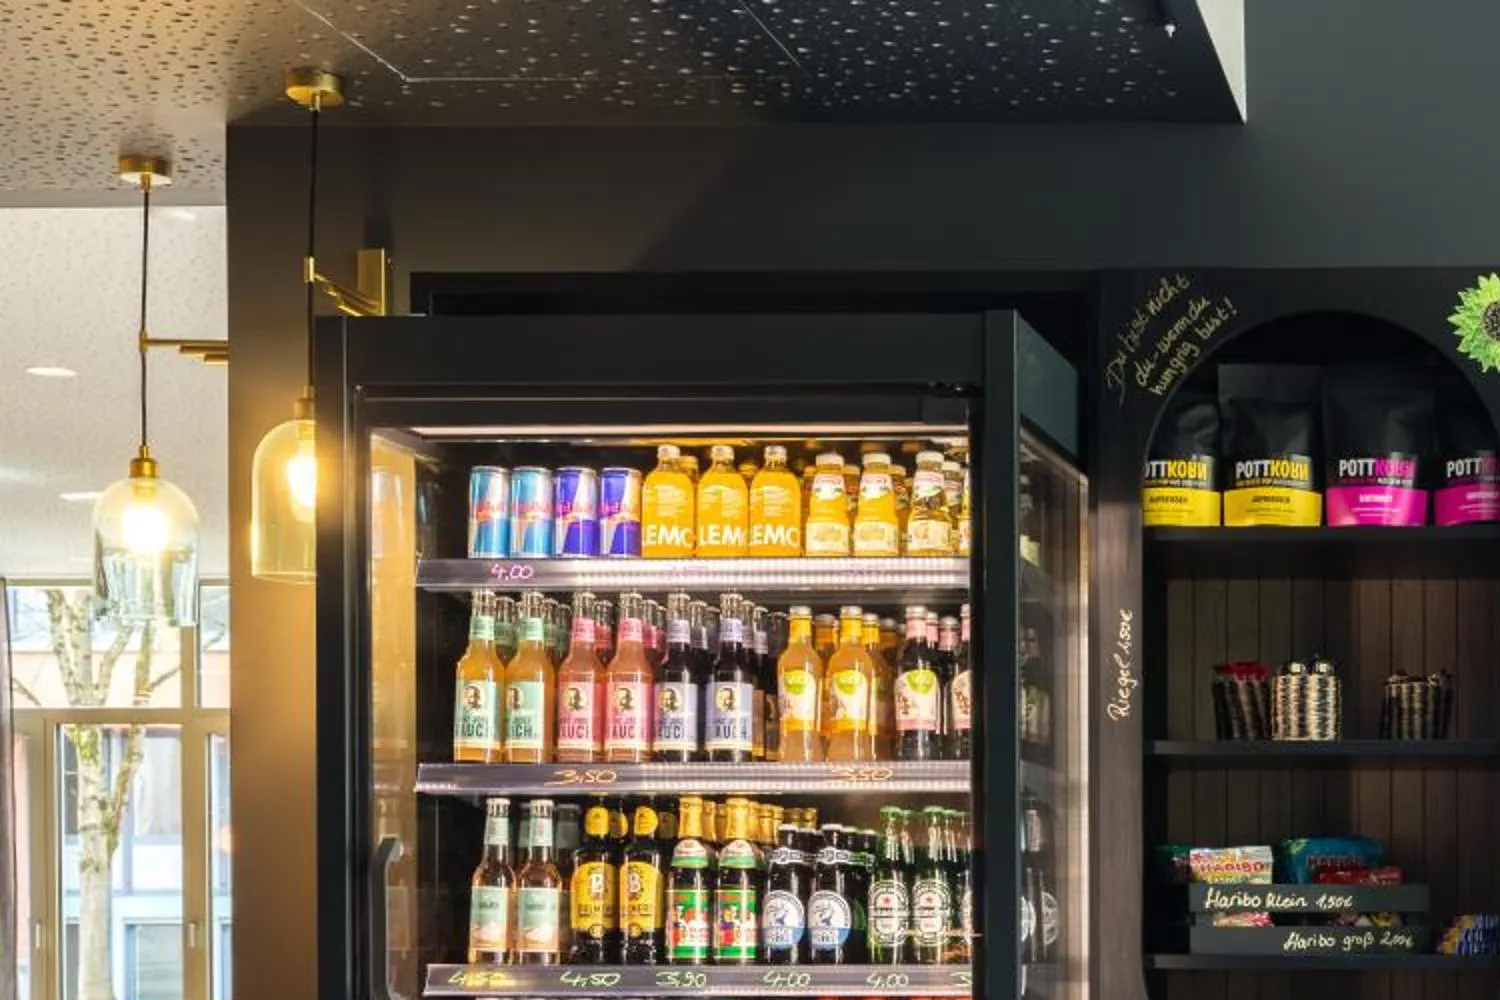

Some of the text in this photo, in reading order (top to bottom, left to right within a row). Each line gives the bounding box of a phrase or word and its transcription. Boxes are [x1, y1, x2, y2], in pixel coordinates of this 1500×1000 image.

[1145, 460, 1207, 481] TTKORN
[1235, 459, 1310, 481] POTTKORN
[1106, 652, 1139, 722] Riegel
[1204, 887, 1261, 909] Haribo
[1283, 931, 1336, 951] Haribo
